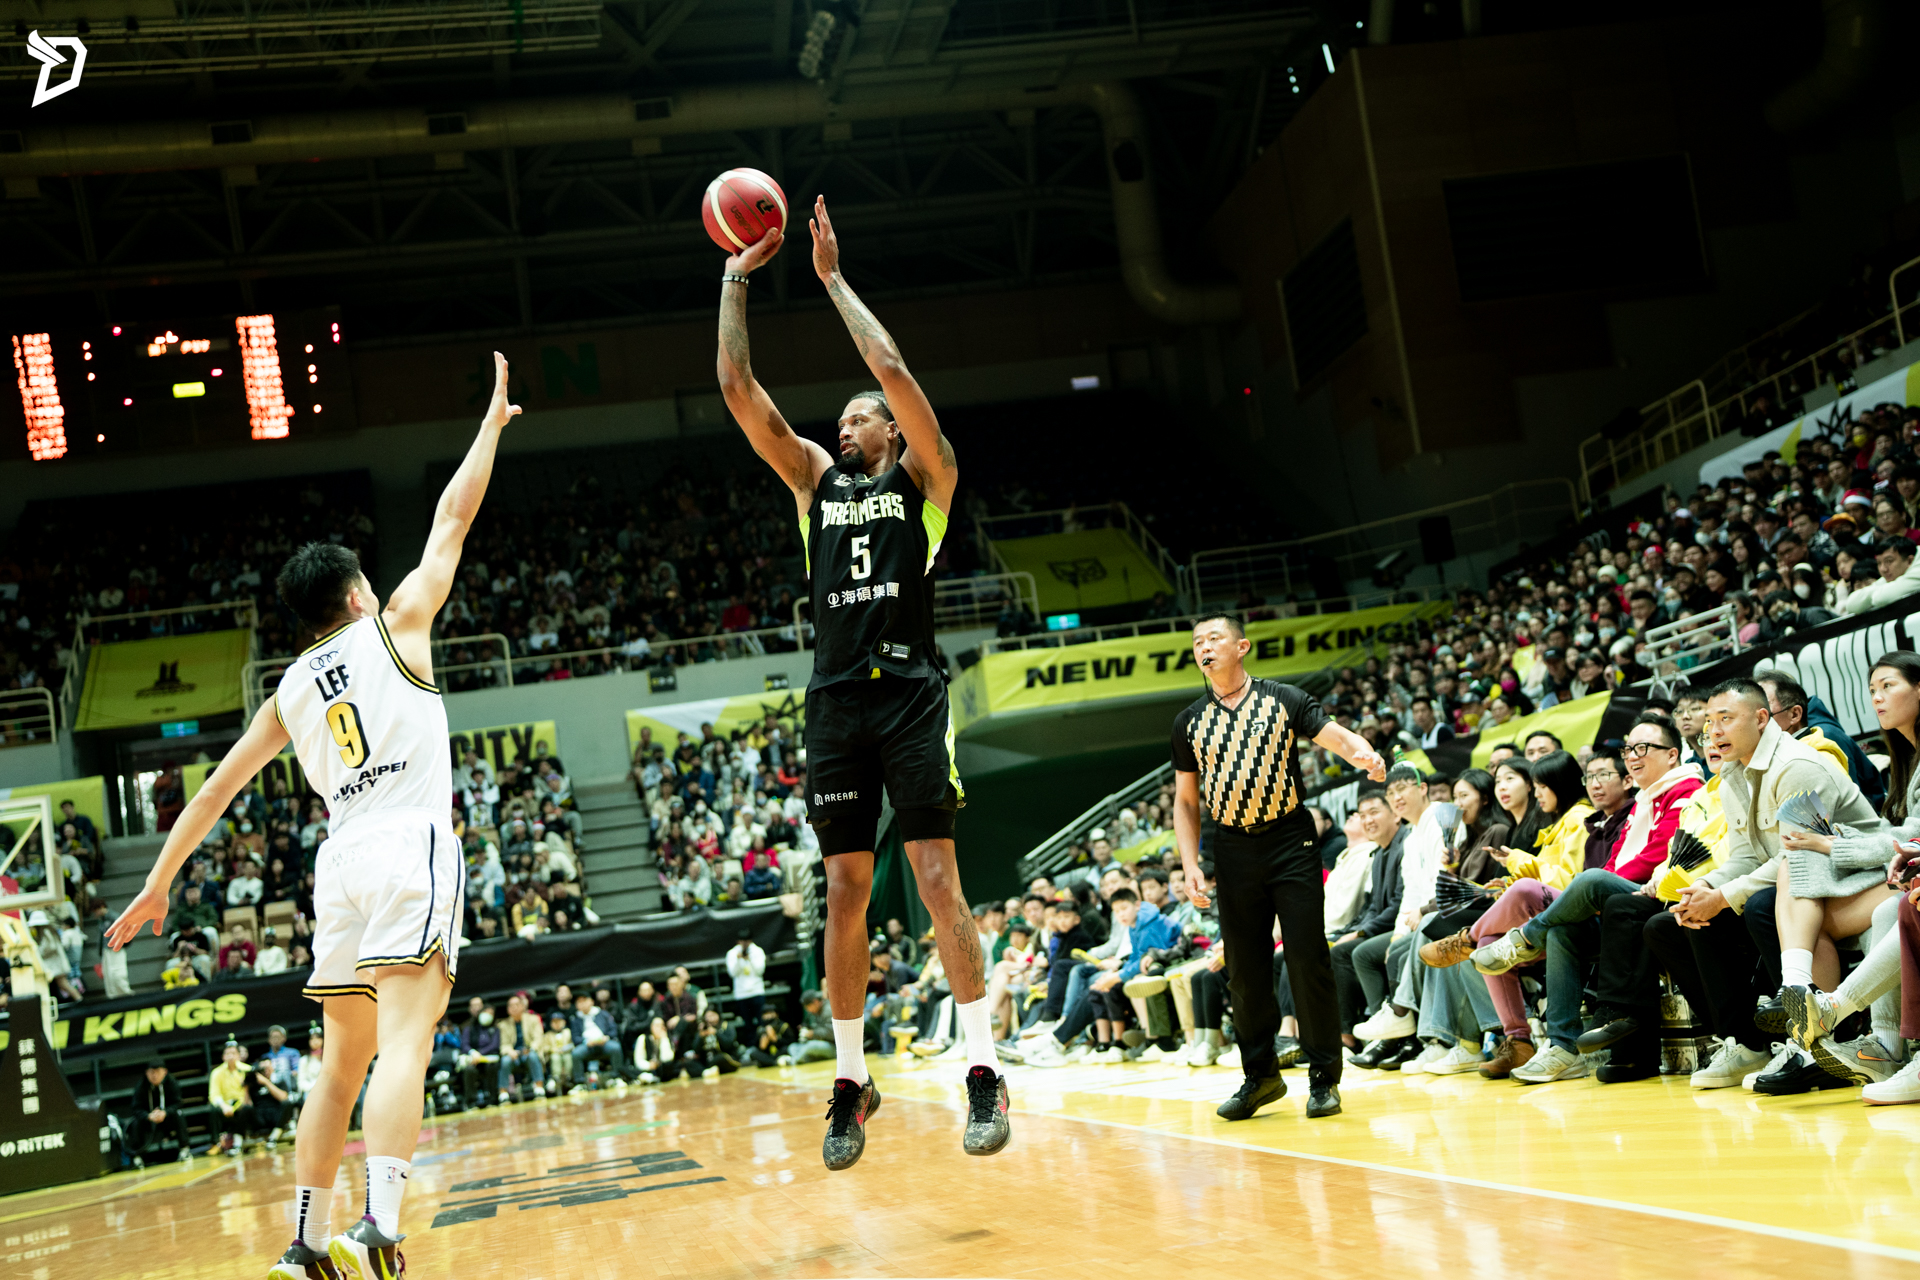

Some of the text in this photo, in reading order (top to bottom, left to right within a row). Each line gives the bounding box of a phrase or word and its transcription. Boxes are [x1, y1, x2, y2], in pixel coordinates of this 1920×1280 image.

[542, 343, 601, 398] N
[821, 494, 905, 530] DREAMERS
[850, 534, 871, 580] 5
[841, 582, 900, 605] 海碩集團
[1026, 656, 1136, 689] NEW
[326, 702, 371, 769] 9
[83, 994, 247, 1045] KINGS
